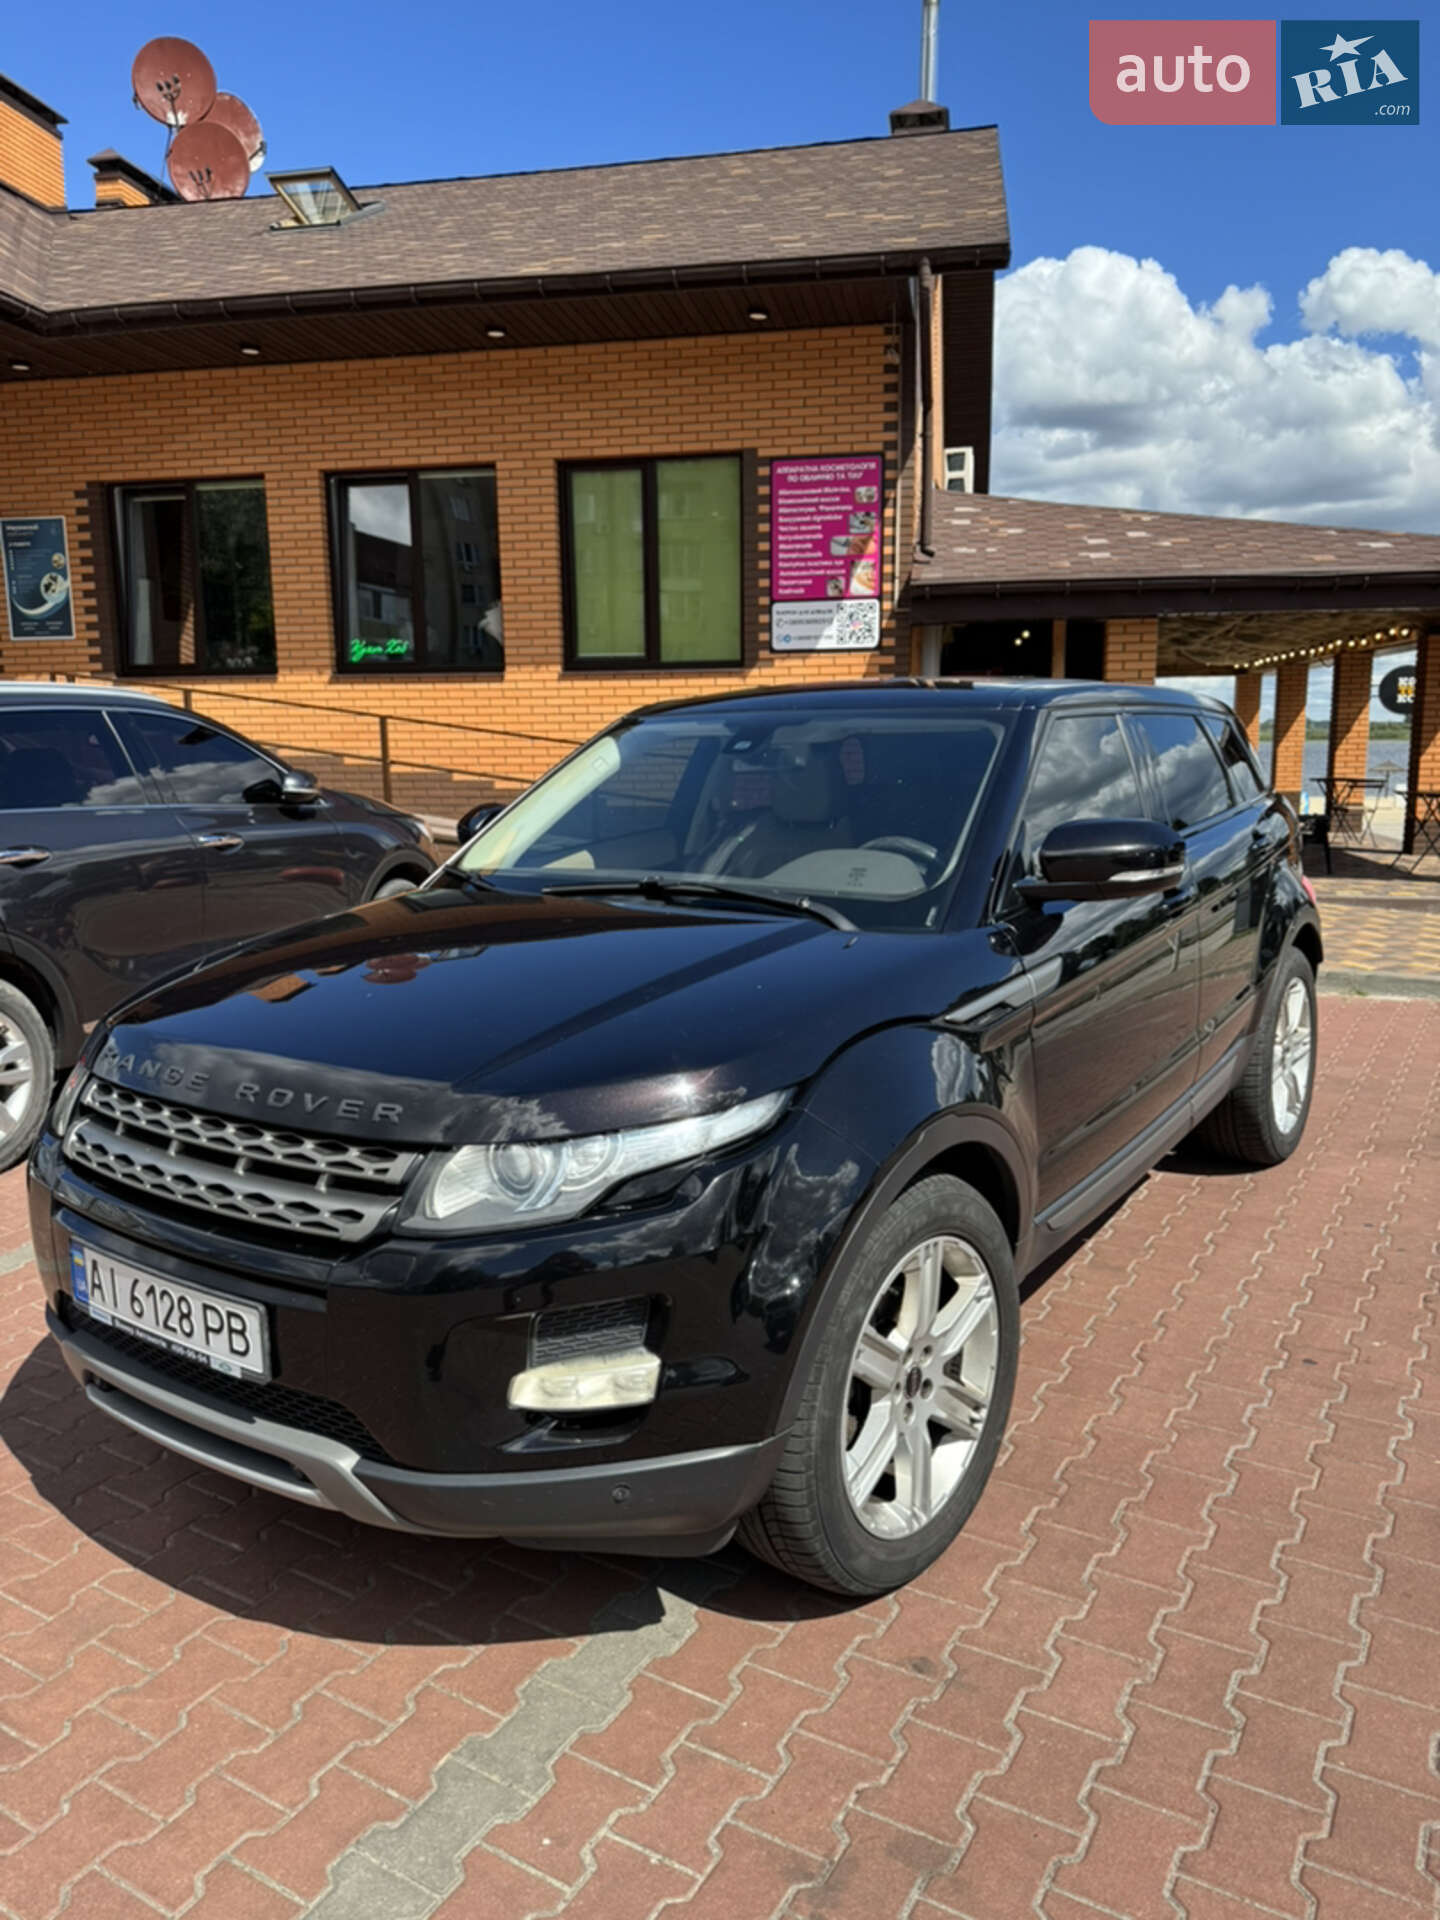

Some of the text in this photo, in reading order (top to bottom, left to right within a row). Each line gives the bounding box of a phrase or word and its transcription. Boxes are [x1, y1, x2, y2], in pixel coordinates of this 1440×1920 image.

[235, 1081, 404, 1123] ROVER
[90, 1259, 250, 1357] AI 6128 PB
